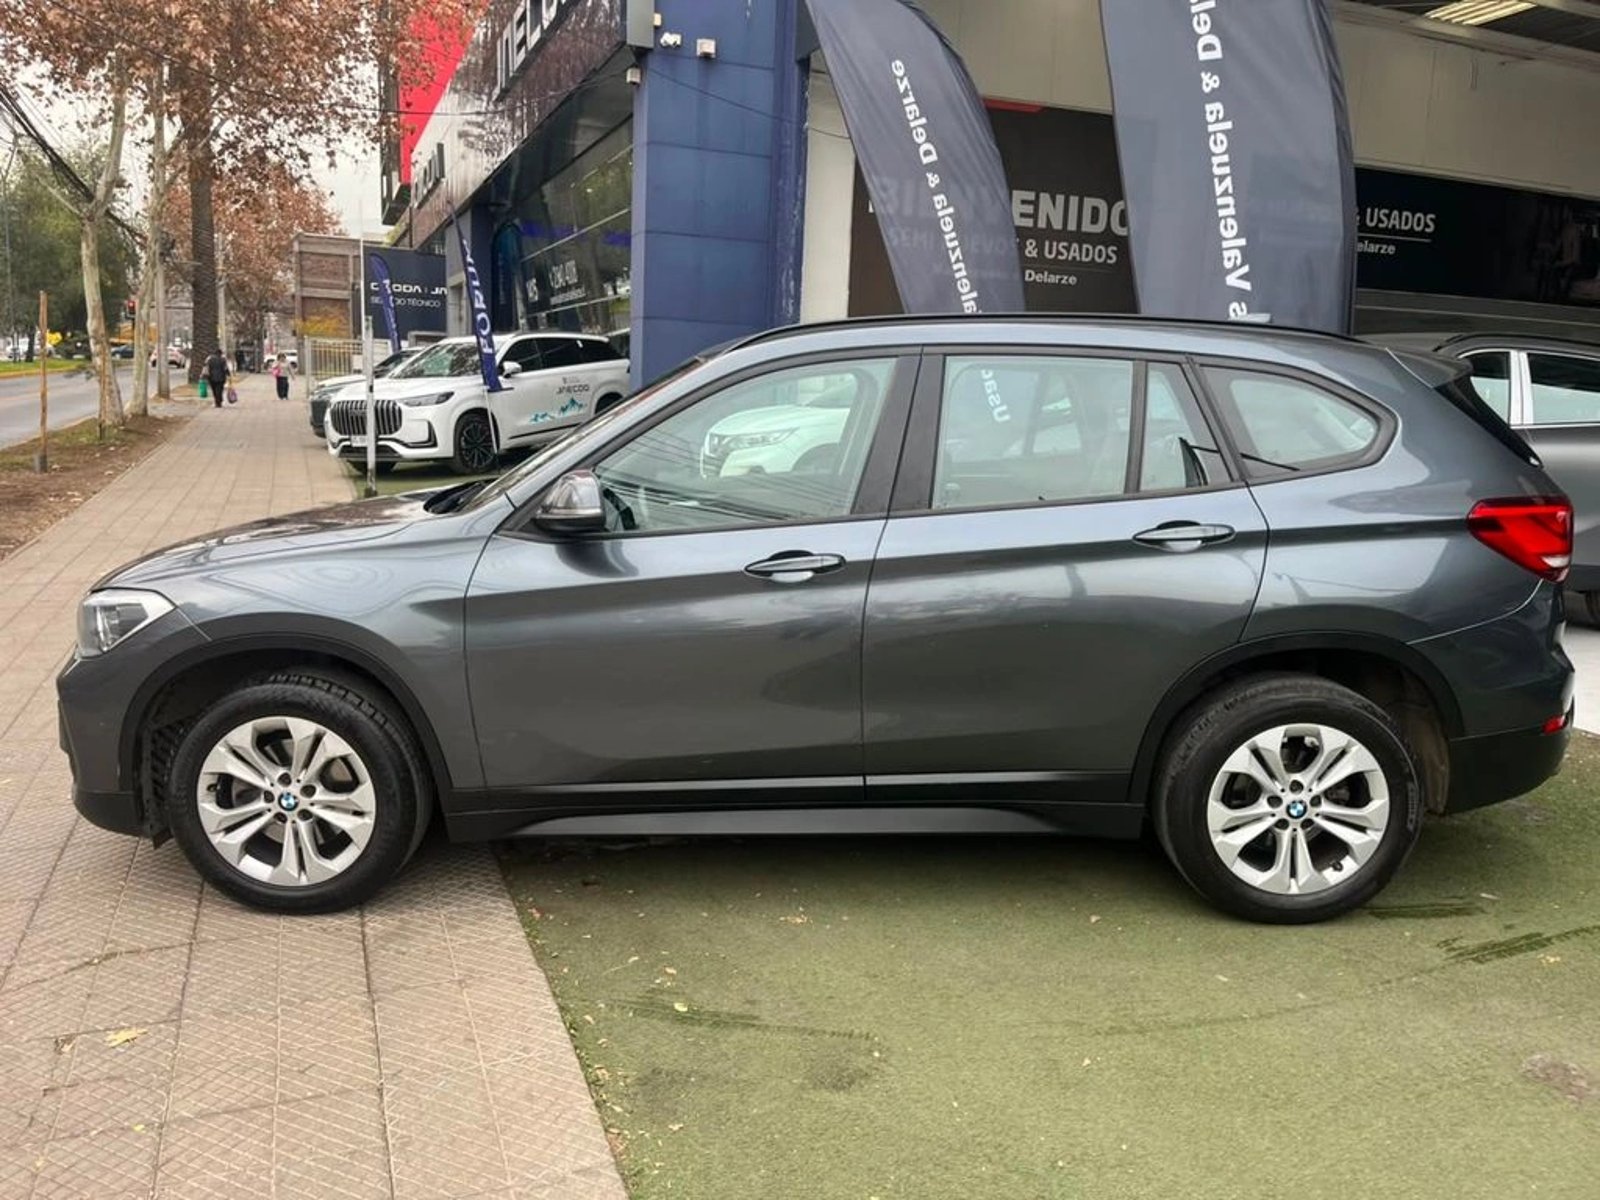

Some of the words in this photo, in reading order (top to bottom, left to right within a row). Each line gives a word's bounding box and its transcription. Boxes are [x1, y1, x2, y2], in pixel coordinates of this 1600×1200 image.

[1365, 207, 1437, 233] USADOS
[1024, 238, 1039, 259] &
[1043, 240, 1118, 264] USADOS
[1356, 240, 1397, 255] elarze
[1024, 269, 1078, 285] Delarze
